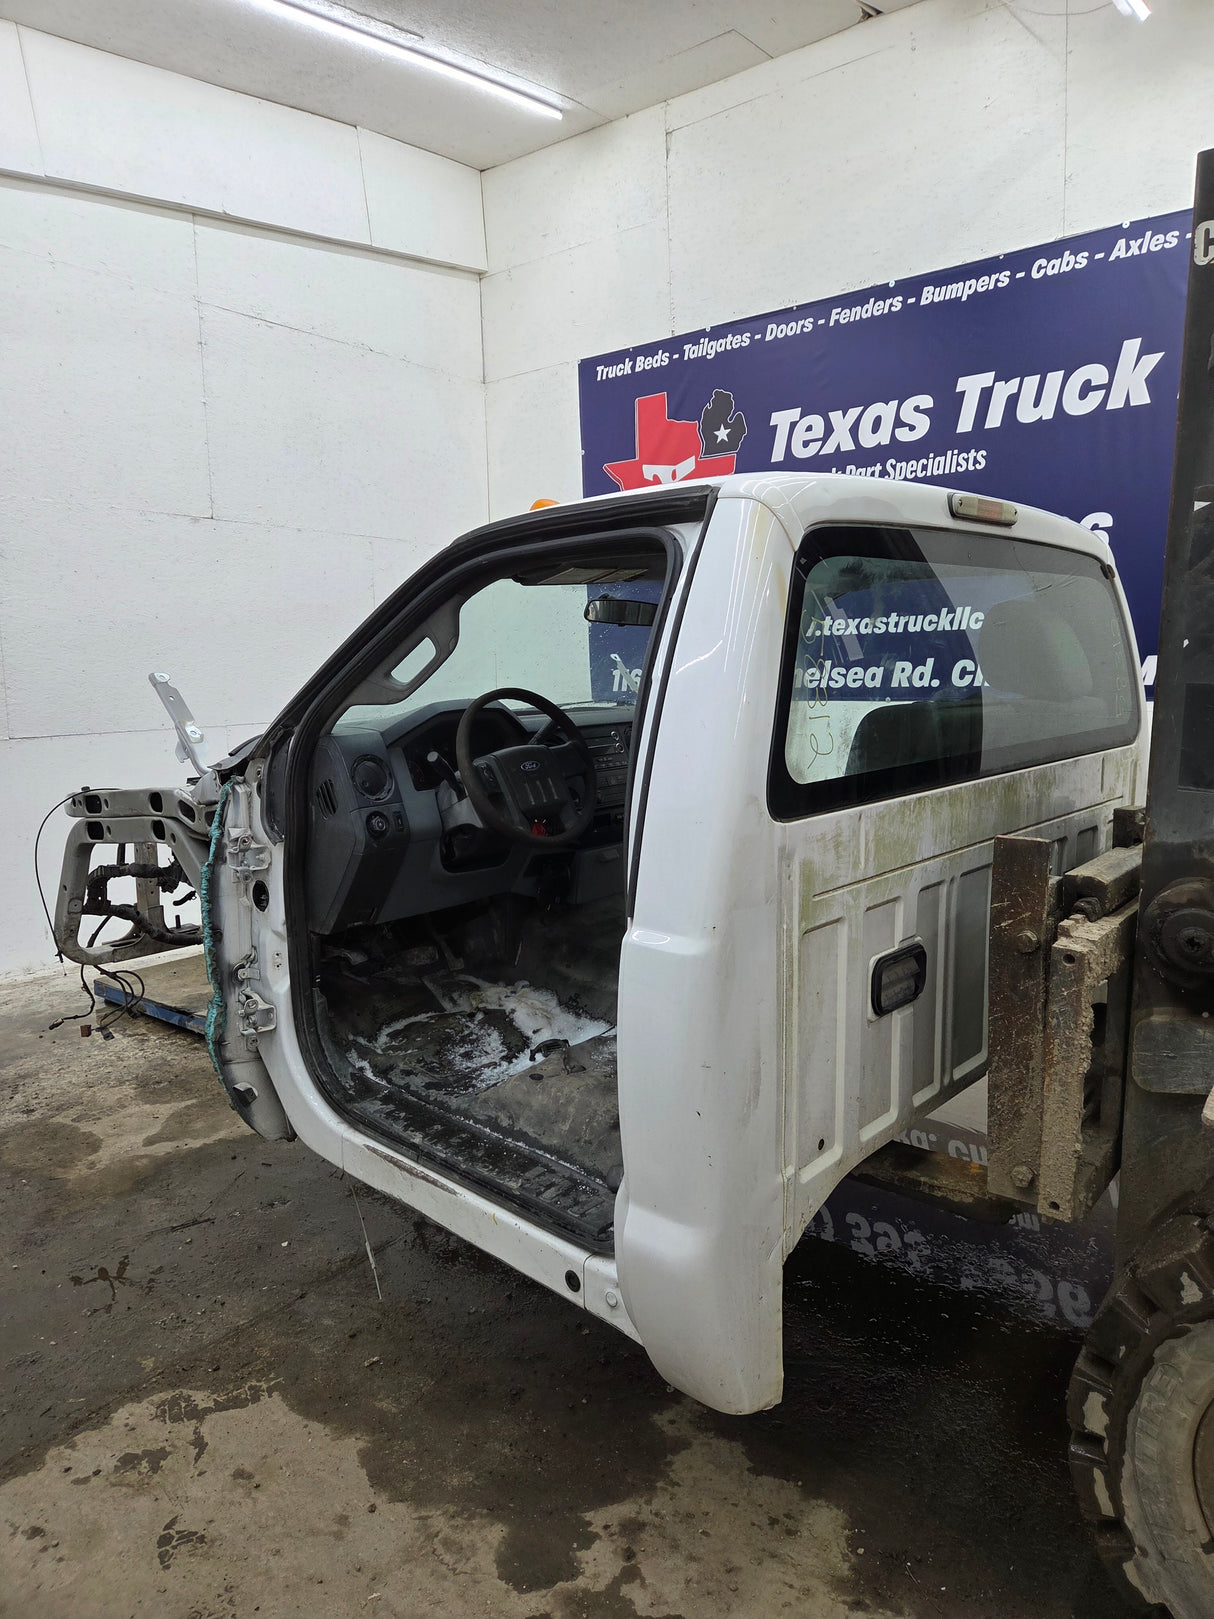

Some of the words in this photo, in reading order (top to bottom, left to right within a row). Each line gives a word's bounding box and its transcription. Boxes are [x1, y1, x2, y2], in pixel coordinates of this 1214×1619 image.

[595, 357, 633, 382] Truck
[635, 350, 669, 373] Beds
[683, 332, 750, 361] Tailgates
[765, 316, 813, 342] Doors
[829, 294, 902, 327] Fenders
[920, 269, 1011, 306] Bumpers
[1031, 250, 1089, 280] Cabs
[1108, 230, 1180, 261] Axles
[769, 394, 934, 463] Texas
[955, 337, 1165, 434] Truck
[884, 449, 987, 481] Specialists
[890, 657, 940, 688] Rd.
